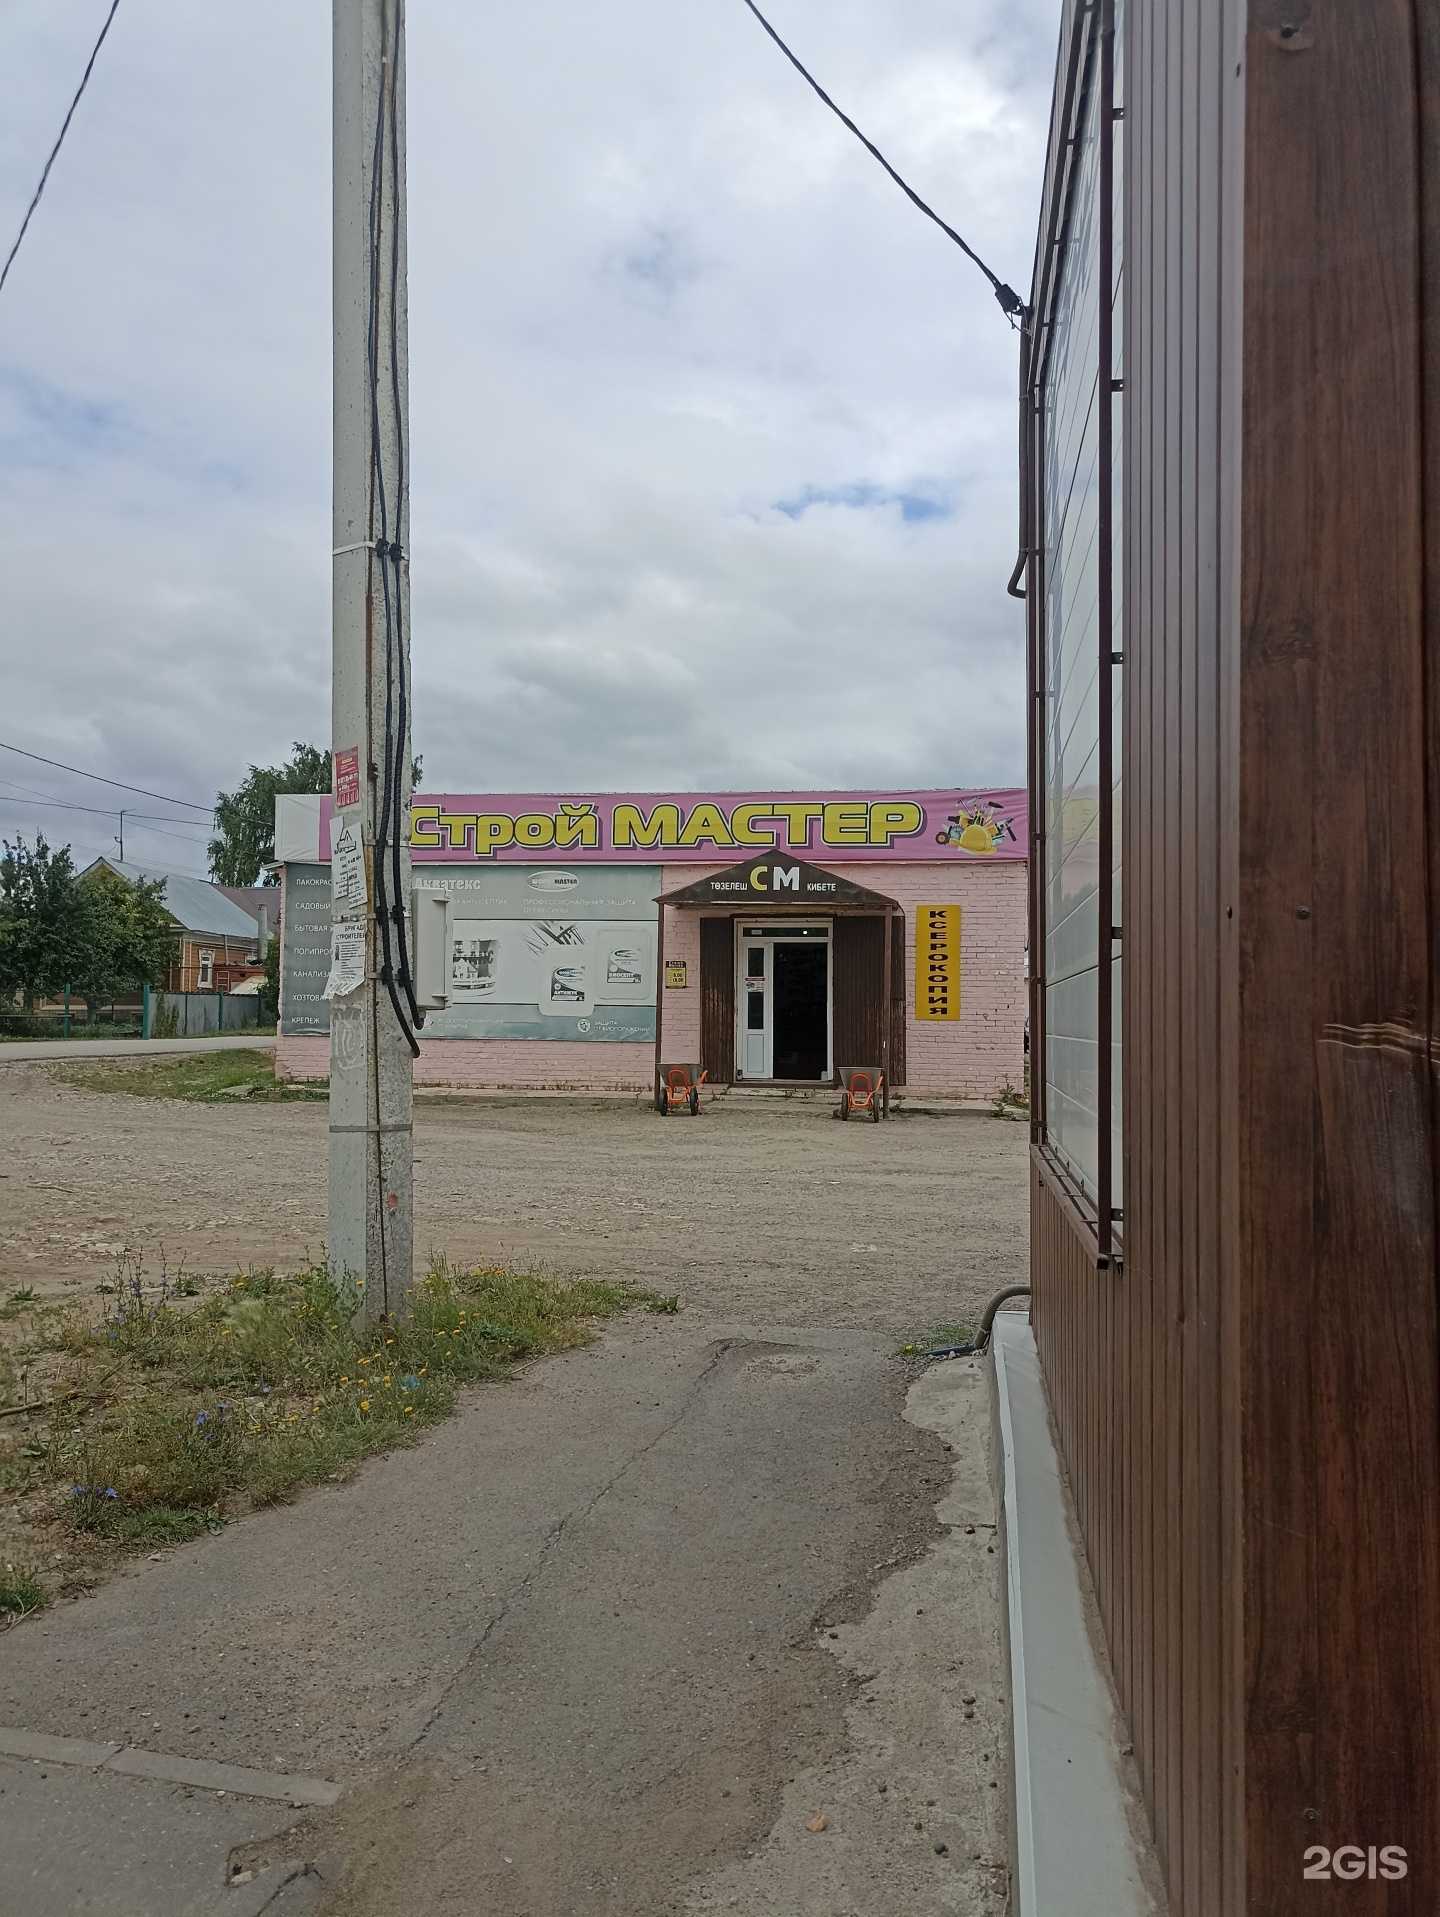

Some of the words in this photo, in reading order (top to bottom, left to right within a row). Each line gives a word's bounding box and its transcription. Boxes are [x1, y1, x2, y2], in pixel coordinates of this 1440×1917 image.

[410, 803, 600, 856] Строй
[612, 801, 924, 849] МАСТЕР
[807, 883, 836, 892] КИБЕТЕ
[928, 910, 949, 1015] КСЕРОКОПИЯ
